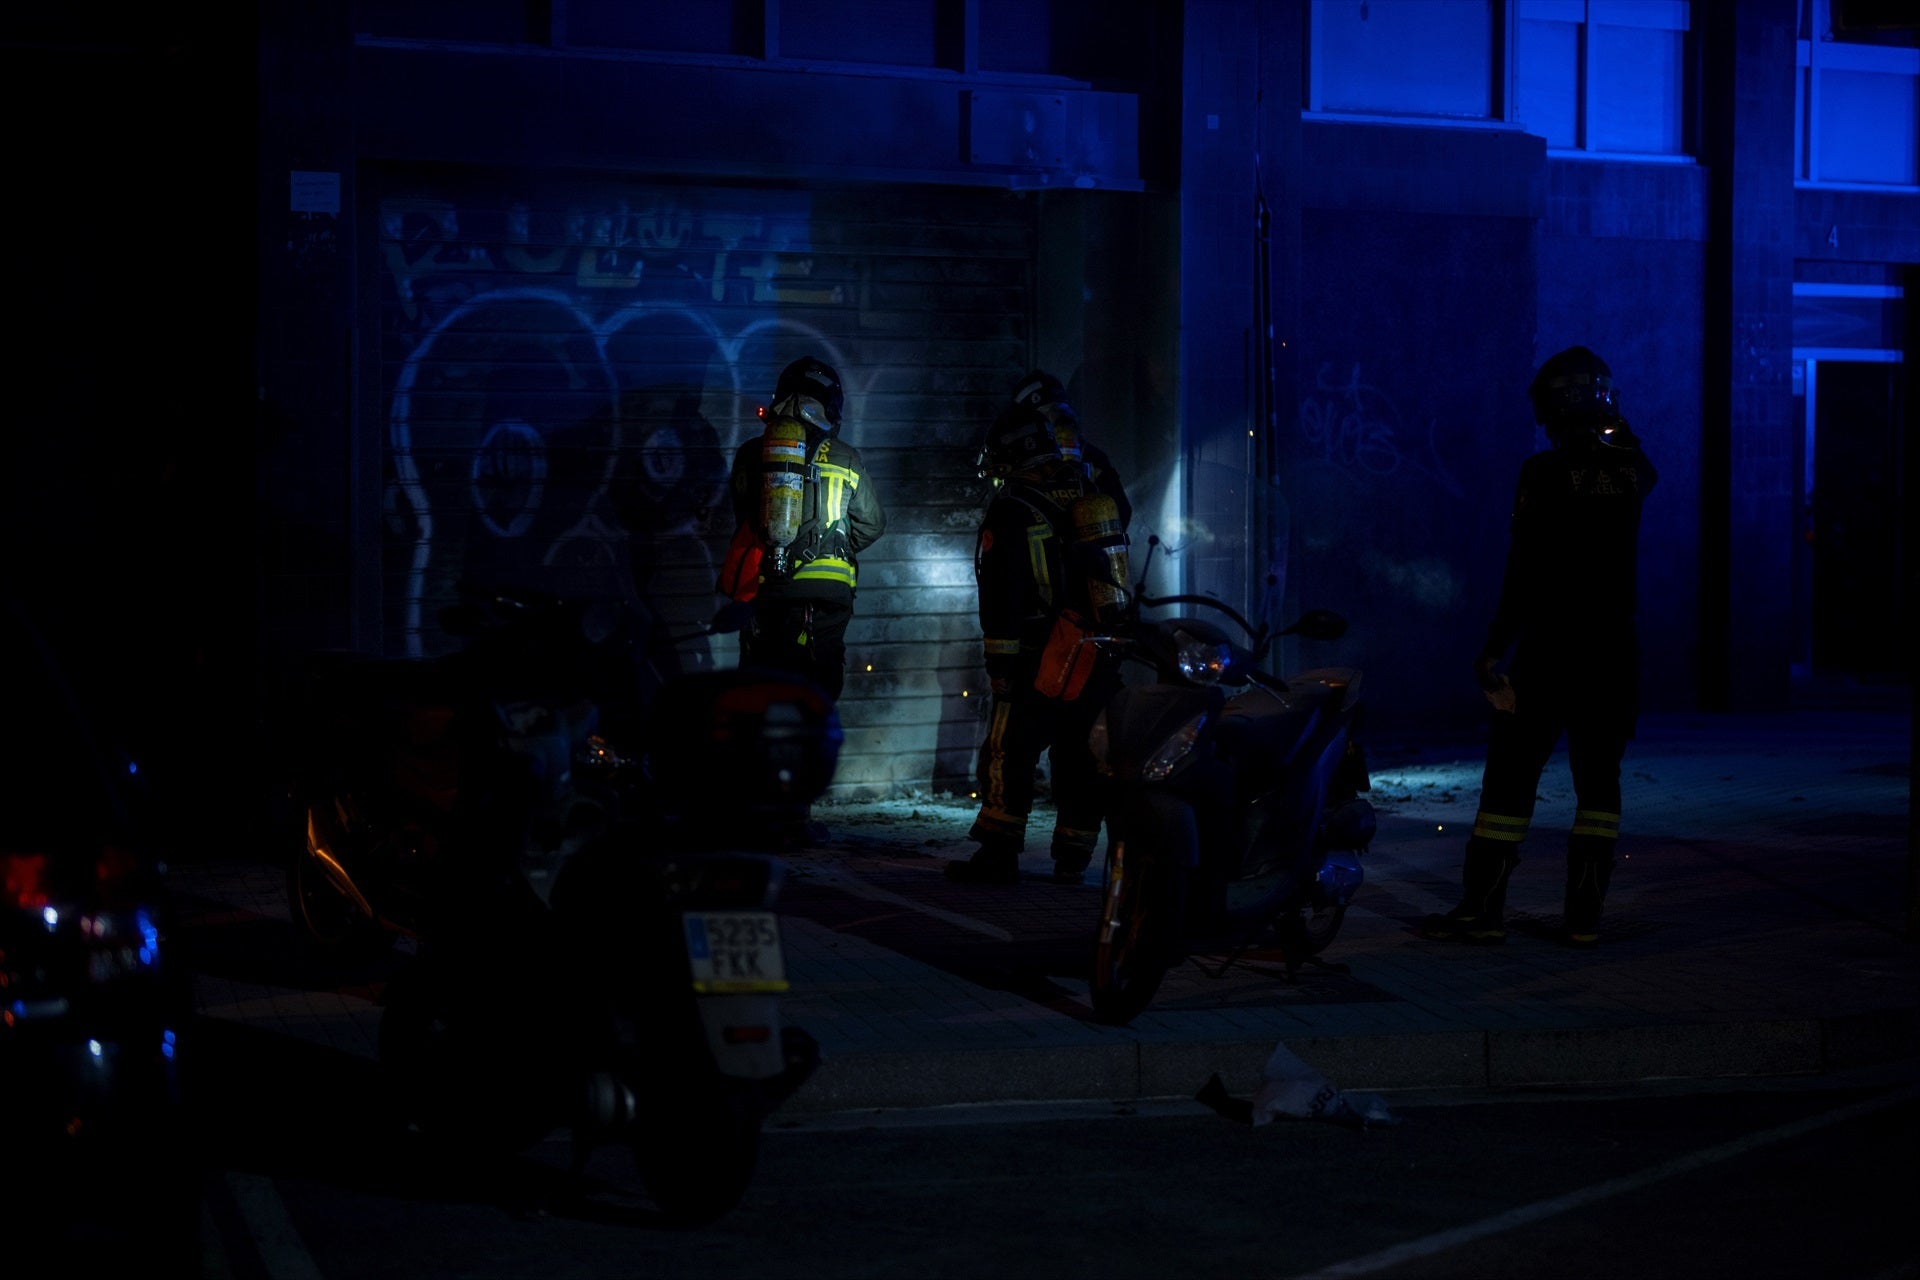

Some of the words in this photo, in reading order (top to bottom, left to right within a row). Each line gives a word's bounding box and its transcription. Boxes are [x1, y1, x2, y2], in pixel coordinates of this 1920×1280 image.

[1827, 224, 1838, 248] 4
[708, 917, 776, 946] 5235
[711, 950, 764, 978] FKK
